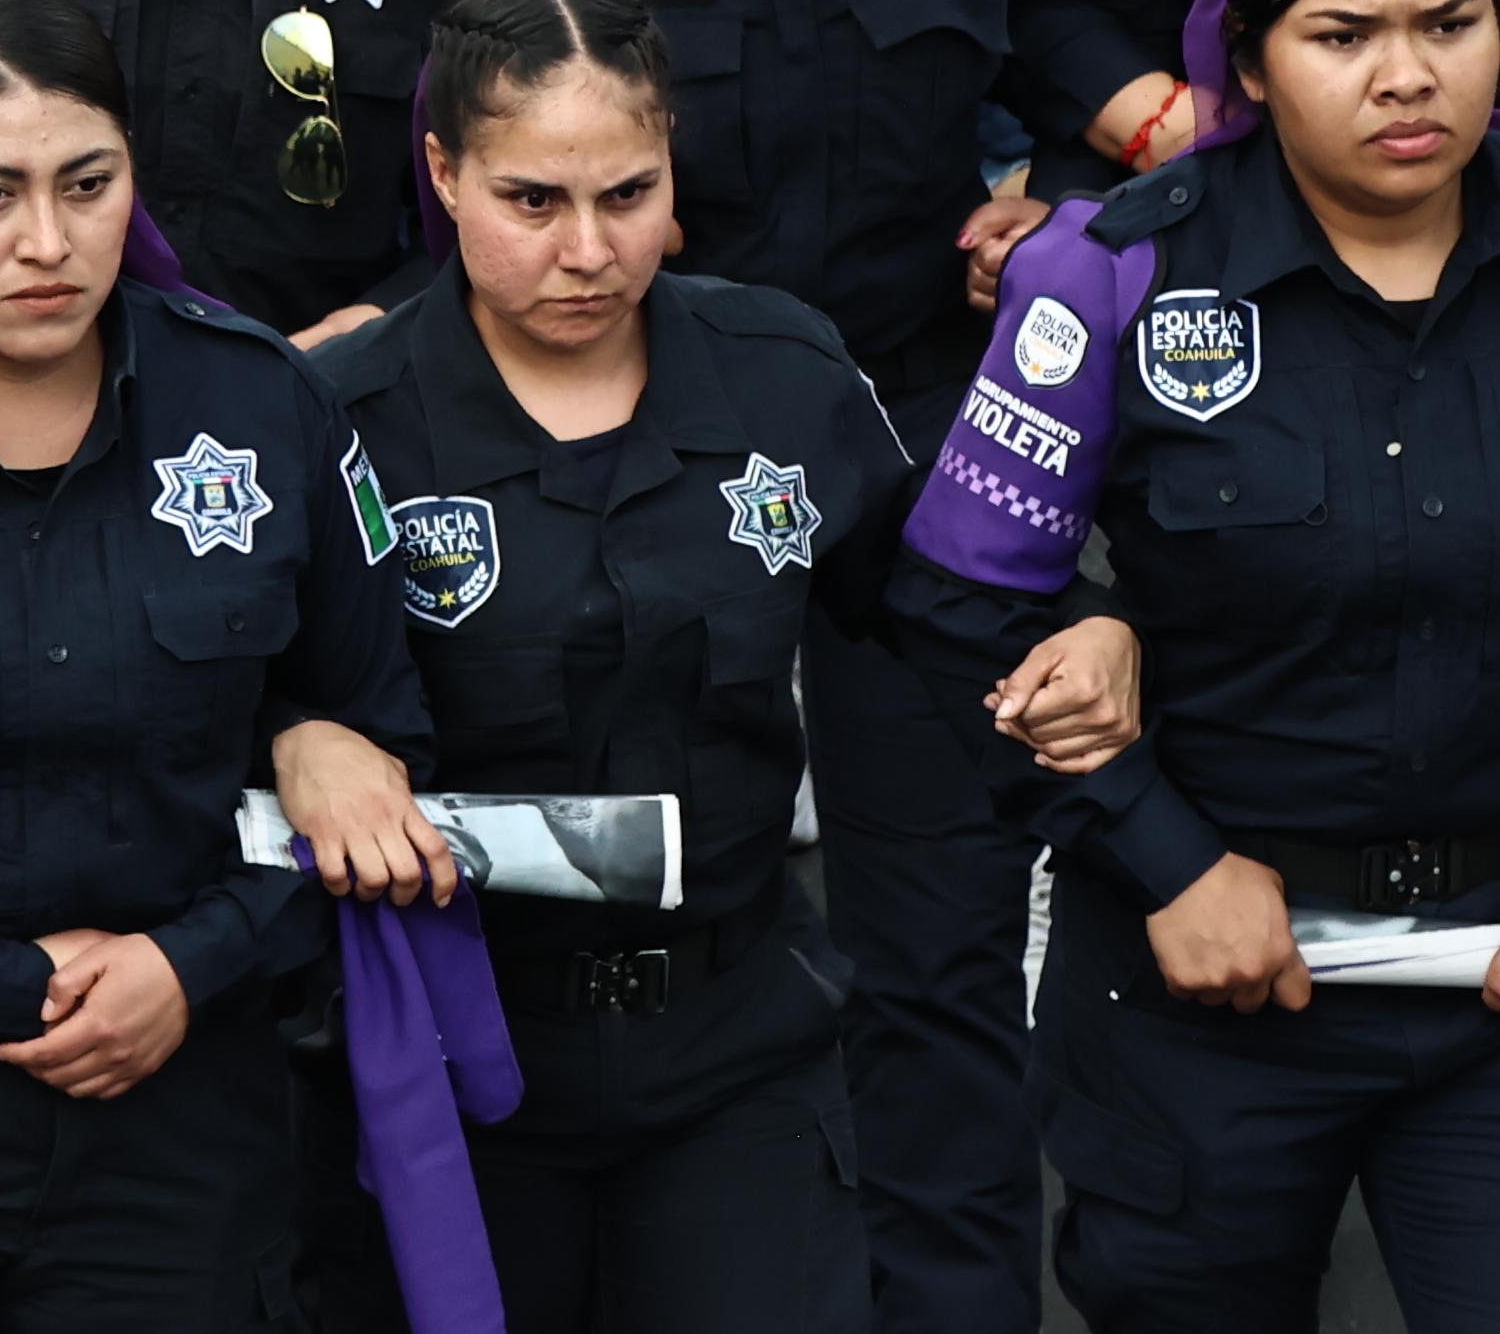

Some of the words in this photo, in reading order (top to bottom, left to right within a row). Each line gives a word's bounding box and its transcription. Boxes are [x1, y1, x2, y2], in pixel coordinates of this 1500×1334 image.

[1151, 307, 1243, 331] POLICÍA
[1031, 321, 1075, 355] ESTATAL
[1152, 329, 1244, 350] ESTATAL
[1165, 347, 1235, 362] COAHUILA
[975, 374, 1081, 446] AGRUPAMIENTO
[963, 390, 1069, 477] VIOLETA
[409, 552, 475, 573] COAHUILA
